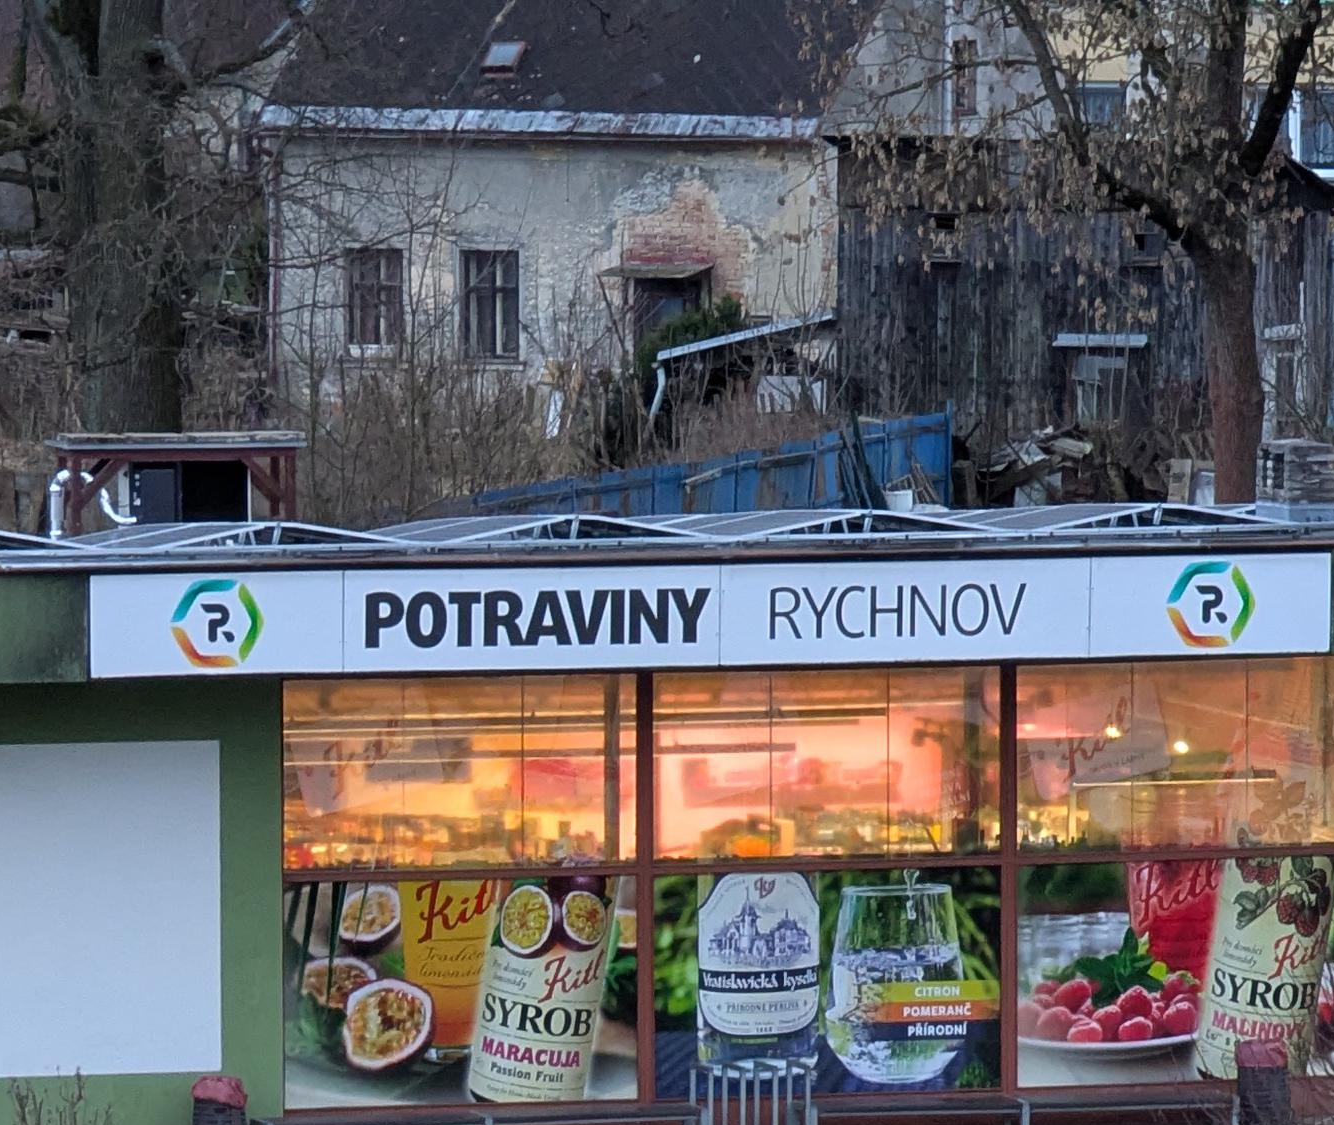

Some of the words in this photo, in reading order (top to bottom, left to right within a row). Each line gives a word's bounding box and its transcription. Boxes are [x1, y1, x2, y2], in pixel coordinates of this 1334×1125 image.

[364, 588, 712, 649] POTRAVINY
[769, 583, 1027, 640] RYCHNOV
[1135, 860, 1220, 928] Kitl
[538, 949, 605, 1004] Kitl
[914, 986, 960, 997] CITRON
[1211, 968, 1316, 1011] SYROB
[482, 992, 592, 1037] SYROB
[903, 1002, 971, 1017] POMERANČ
[907, 1021, 967, 1037] PŘÍRODNÍ
[481, 1035, 580, 1068] MARACUJA
[490, 1062, 531, 1081] Passion
[535, 1070, 564, 1083] Fruit
